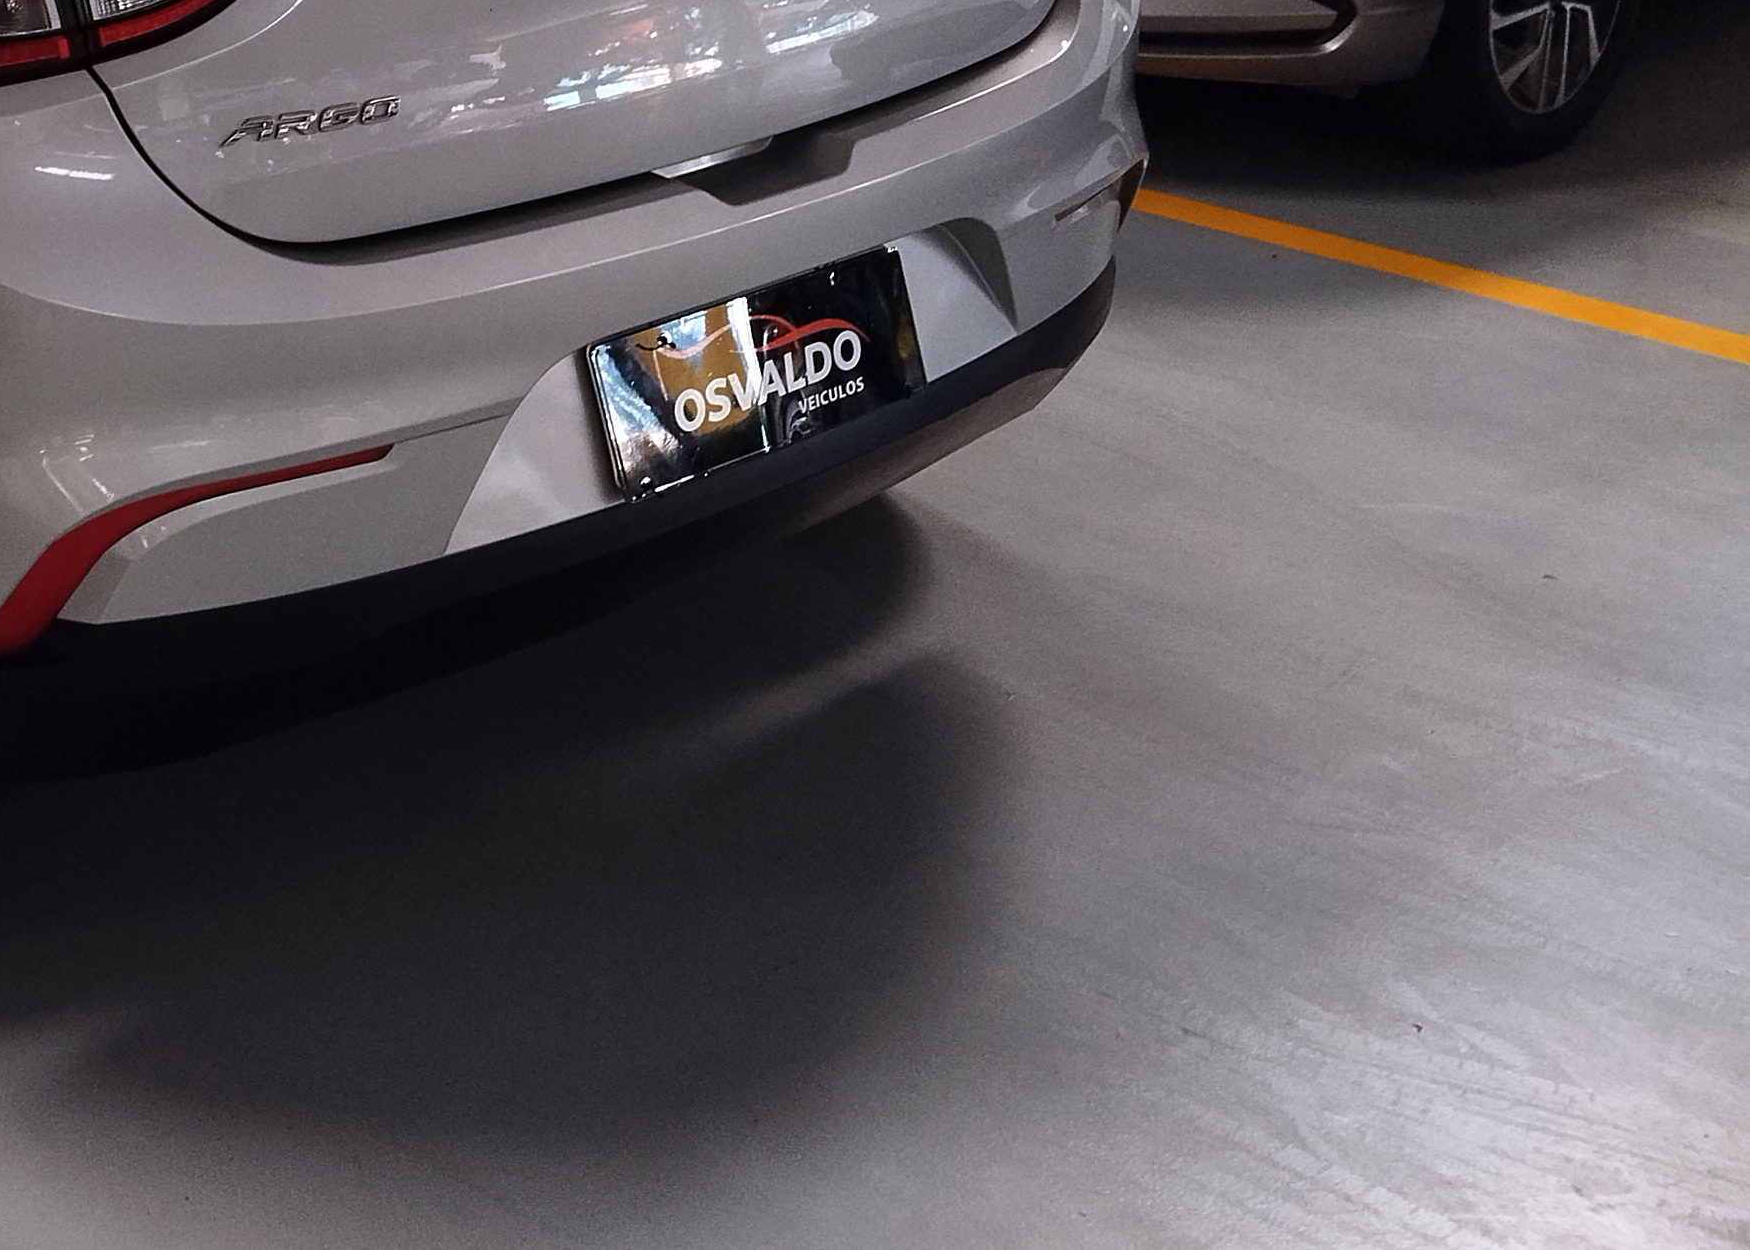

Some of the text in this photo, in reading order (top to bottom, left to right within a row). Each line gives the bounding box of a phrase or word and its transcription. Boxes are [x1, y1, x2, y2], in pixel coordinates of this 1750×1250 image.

[219, 95, 401, 148] ARGO
[674, 330, 862, 432] OSVALDO
[798, 377, 865, 414] VEICULOS
